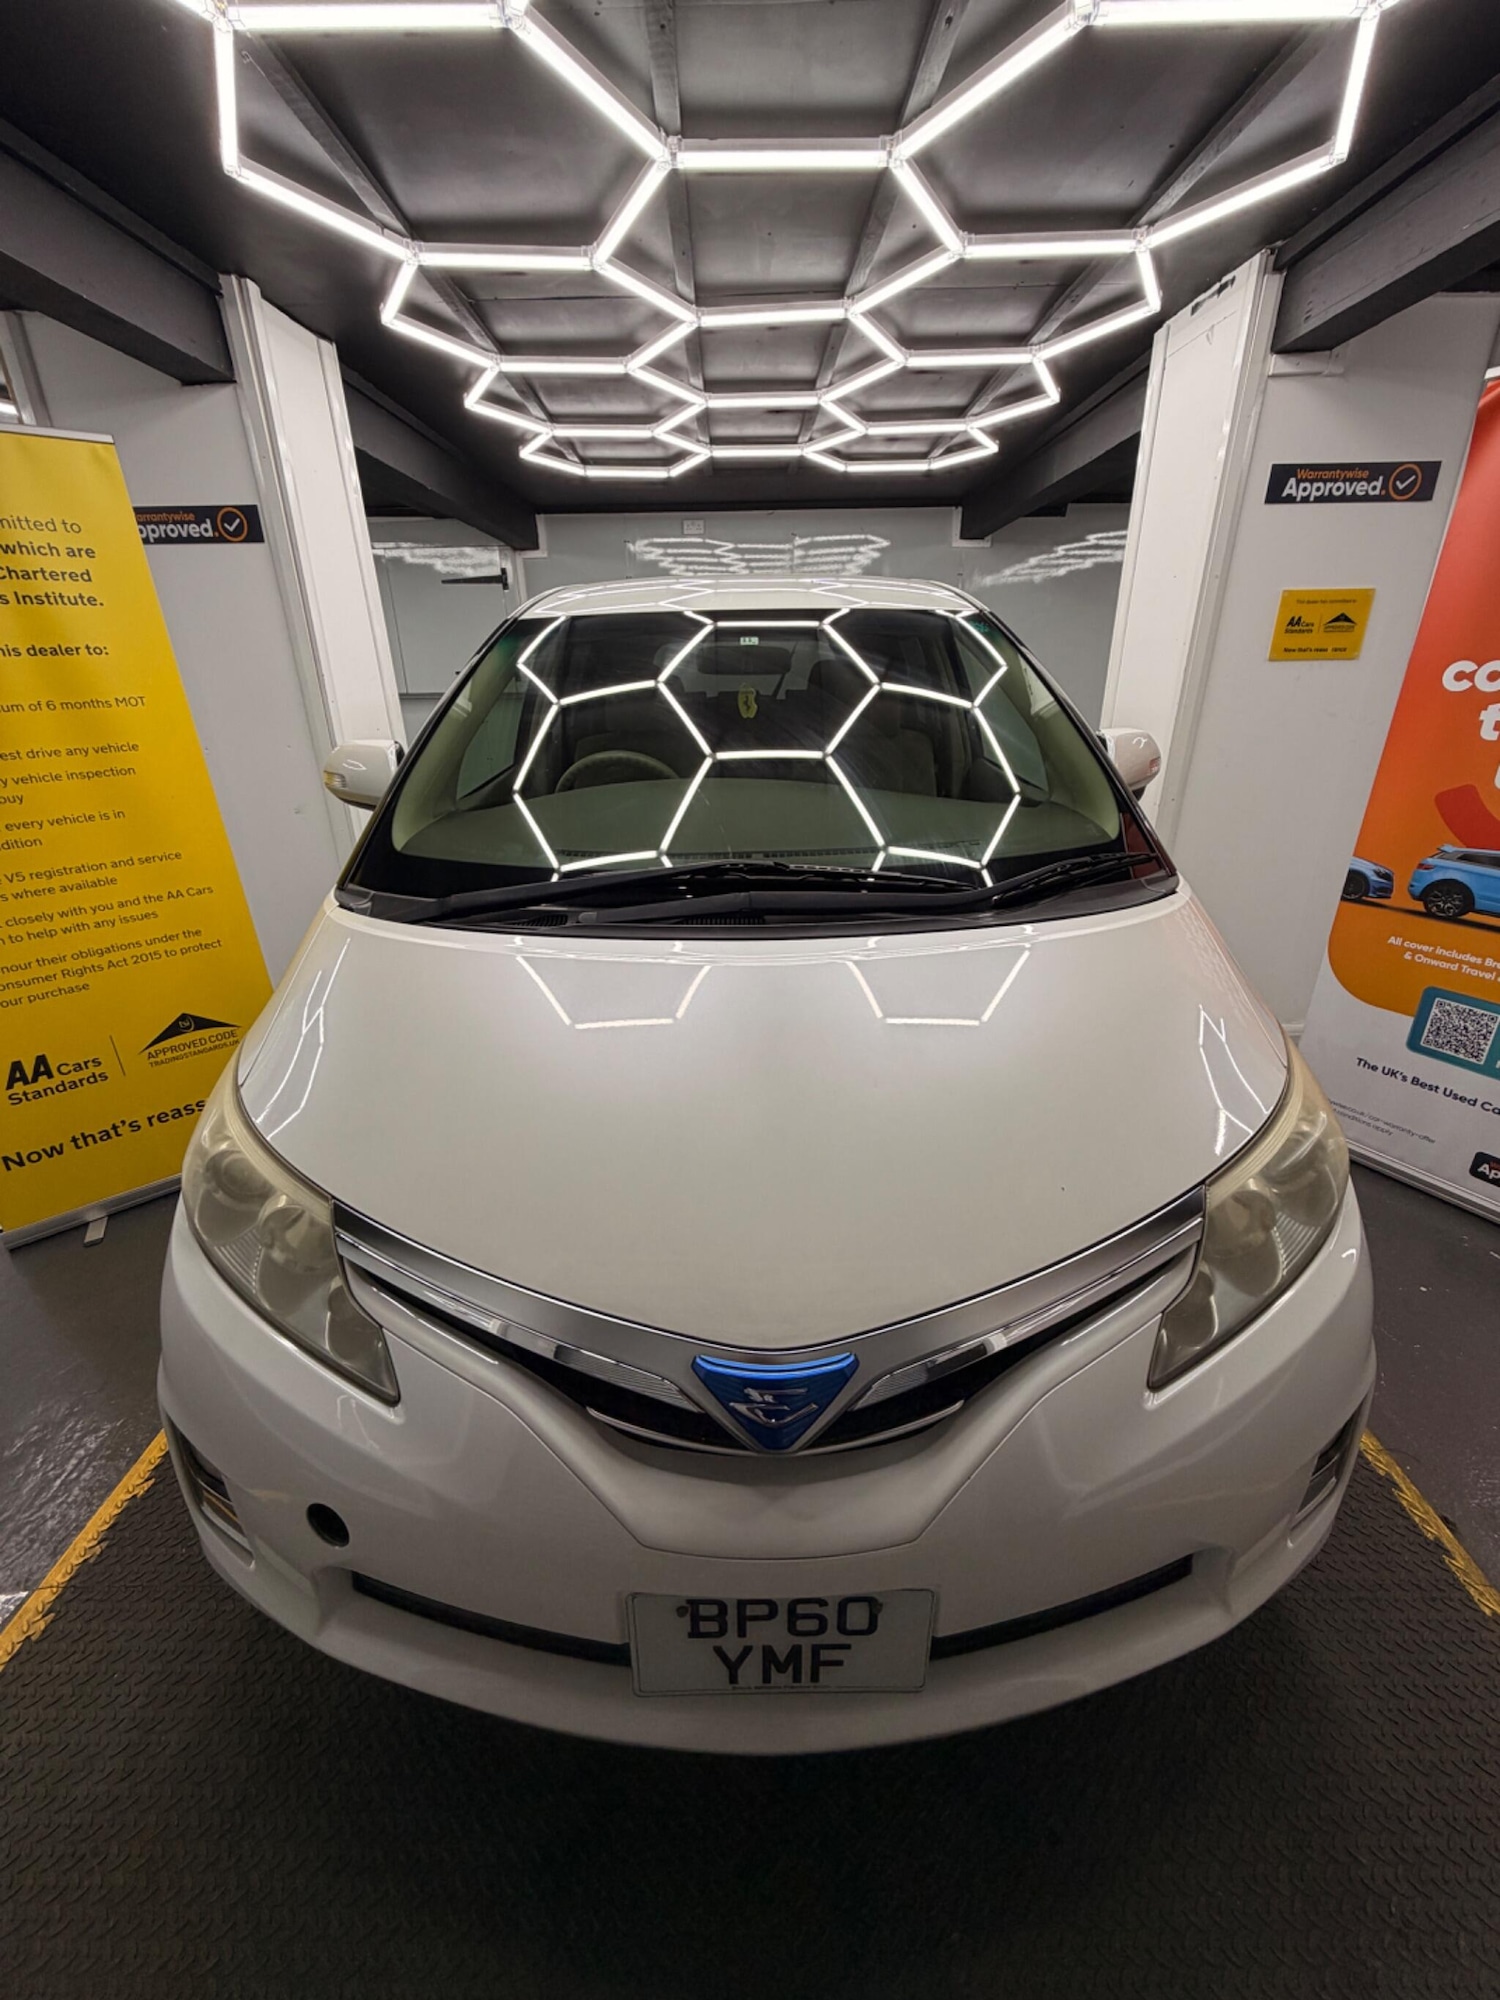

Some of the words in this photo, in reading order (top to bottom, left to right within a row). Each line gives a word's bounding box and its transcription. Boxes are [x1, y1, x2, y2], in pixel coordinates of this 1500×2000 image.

[1296, 468, 1370, 480] Warrantywise
[62, 519, 82, 533] to
[0, 541, 61, 557] which
[66, 546, 96, 558] are
[13, 591, 104, 607] Institute.
[26, 644, 81, 657] dealer
[85, 644, 110, 656] to:
[28, 700, 43, 712] of
[46, 700, 57, 711] 6
[60, 698, 112, 711] months
[114, 696, 146, 708] MOT
[26, 748, 62, 759] drive
[65, 747, 89, 757] any
[92, 742, 140, 755] vehicle
[11, 772, 63, 785] vehicle
[65, 766, 136, 781] inspection
[5, 819, 44, 832] every
[47, 813, 96, 827] vehicle
[98, 811, 110, 821] is
[112, 809, 126, 819] in
[29, 861, 108, 880] registration
[110, 856, 135, 869] and
[137, 851, 182, 866] service
[11, 884, 56, 900] where
[59, 876, 118, 893] available
[5, 911, 54, 928] closely
[57, 905, 87, 919] with
[90, 902, 114, 916] you
[117, 897, 141, 909] and
[142, 893, 164, 905] the
[167, 889, 185, 901] AA
[186, 886, 214, 898] Cars
[8, 933, 24, 944] to
[26, 928, 58, 943] help
[61, 921, 91, 935] with
[93, 917, 116, 930] any
[118, 910, 158, 925] issues
[36, 952, 67, 968] their
[71, 940, 142, 960] obligations
[145, 932, 180, 947] under
[182, 928, 202, 939] the
[61, 962, 104, 979] Rights
[107, 956, 129, 970] Act
[131, 949, 162, 965] 2015
[164, 948, 177, 958] to
[179, 938, 222, 956] protect
[1387, 936, 1403, 946] All
[1403, 941, 1435, 952] cover
[1435, 946, 1482, 964] includes
[1403, 952, 1413, 960] &
[1414, 954, 1459, 971] Onward
[1461, 964, 1496, 980] Travel
[27, 982, 91, 1004] purchase
[147, 1036, 207, 1060] APPROVED
[208, 1029, 238, 1044] CODE
[5, 1053, 54, 1091] AA
[56, 1055, 103, 1077] Cars
[1356, 1057, 1379, 1072] The
[1381, 1066, 1408, 1083] UK's
[1410, 1076, 1440, 1094] Best
[1443, 1087, 1478, 1107] Used
[7, 1069, 109, 1107] Standards
[1, 1141, 65, 1172] Now
[70, 1119, 141, 1150] that's
[686, 1596, 879, 1639] BP60
[712, 1643, 852, 1685] YMF
